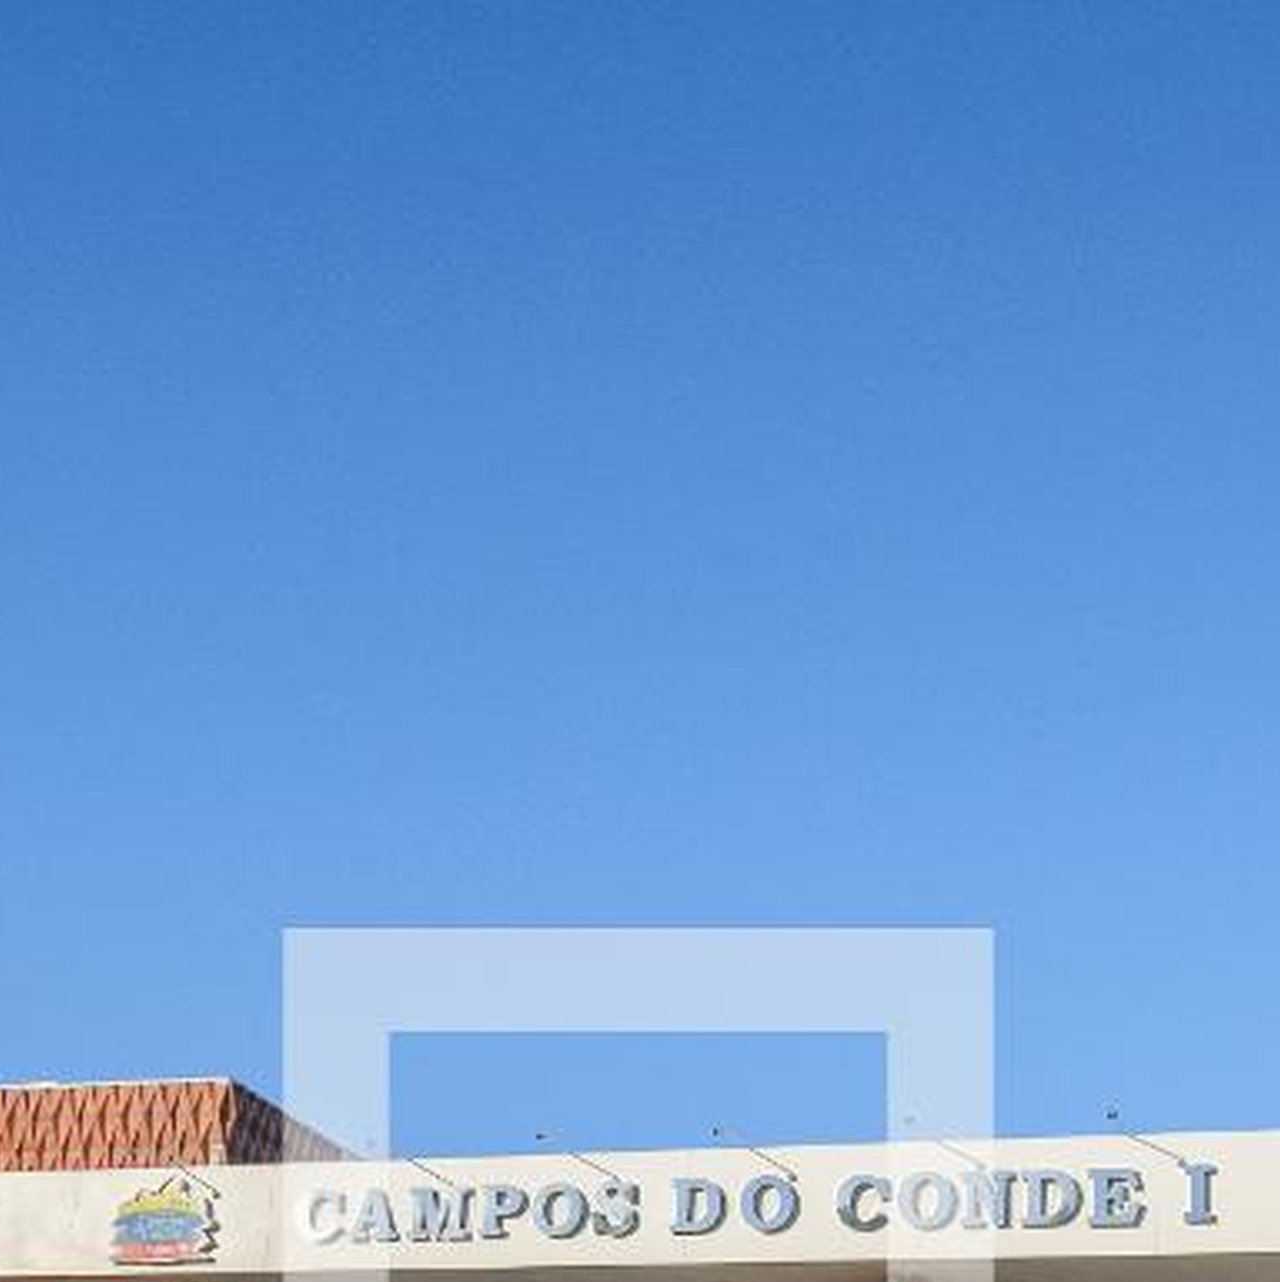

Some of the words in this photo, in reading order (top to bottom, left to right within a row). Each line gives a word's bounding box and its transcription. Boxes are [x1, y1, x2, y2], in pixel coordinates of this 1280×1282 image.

[303, 1178, 642, 1244] CAMPOS
[669, 1172, 801, 1236] DO
[836, 1167, 1148, 1233] CONDE
[1183, 1160, 1218, 1227] I
